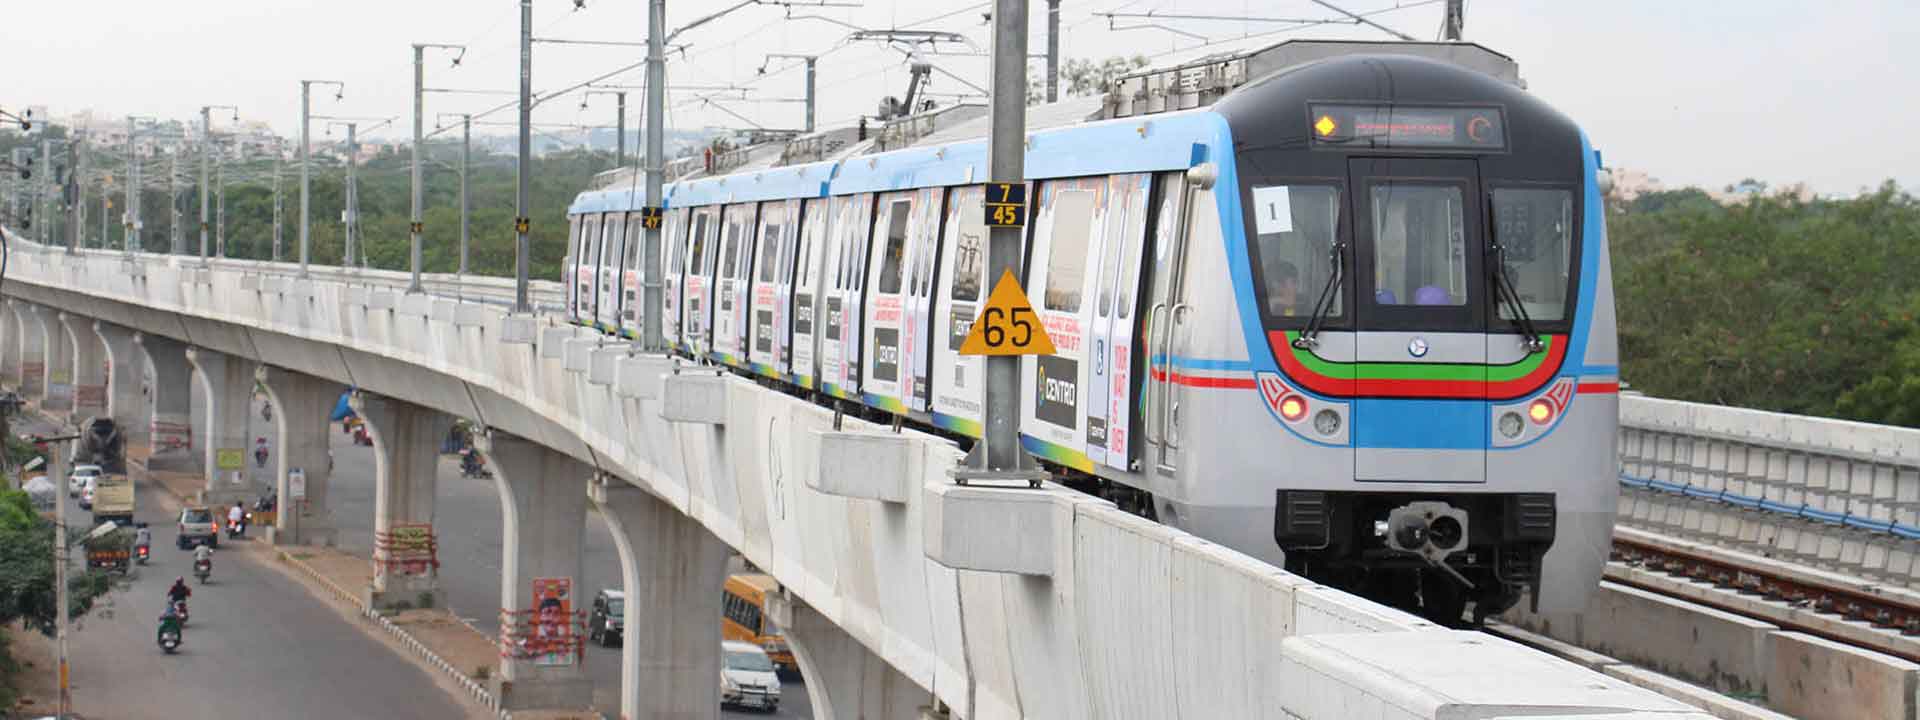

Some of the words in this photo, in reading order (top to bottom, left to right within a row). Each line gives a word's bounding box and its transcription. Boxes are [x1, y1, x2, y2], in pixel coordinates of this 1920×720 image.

[999, 184, 1011, 203] 7
[993, 206, 1016, 225] 45
[1269, 202, 1278, 221] 1
[983, 307, 1032, 347] 65
[1046, 377, 1075, 406] CENTRO
